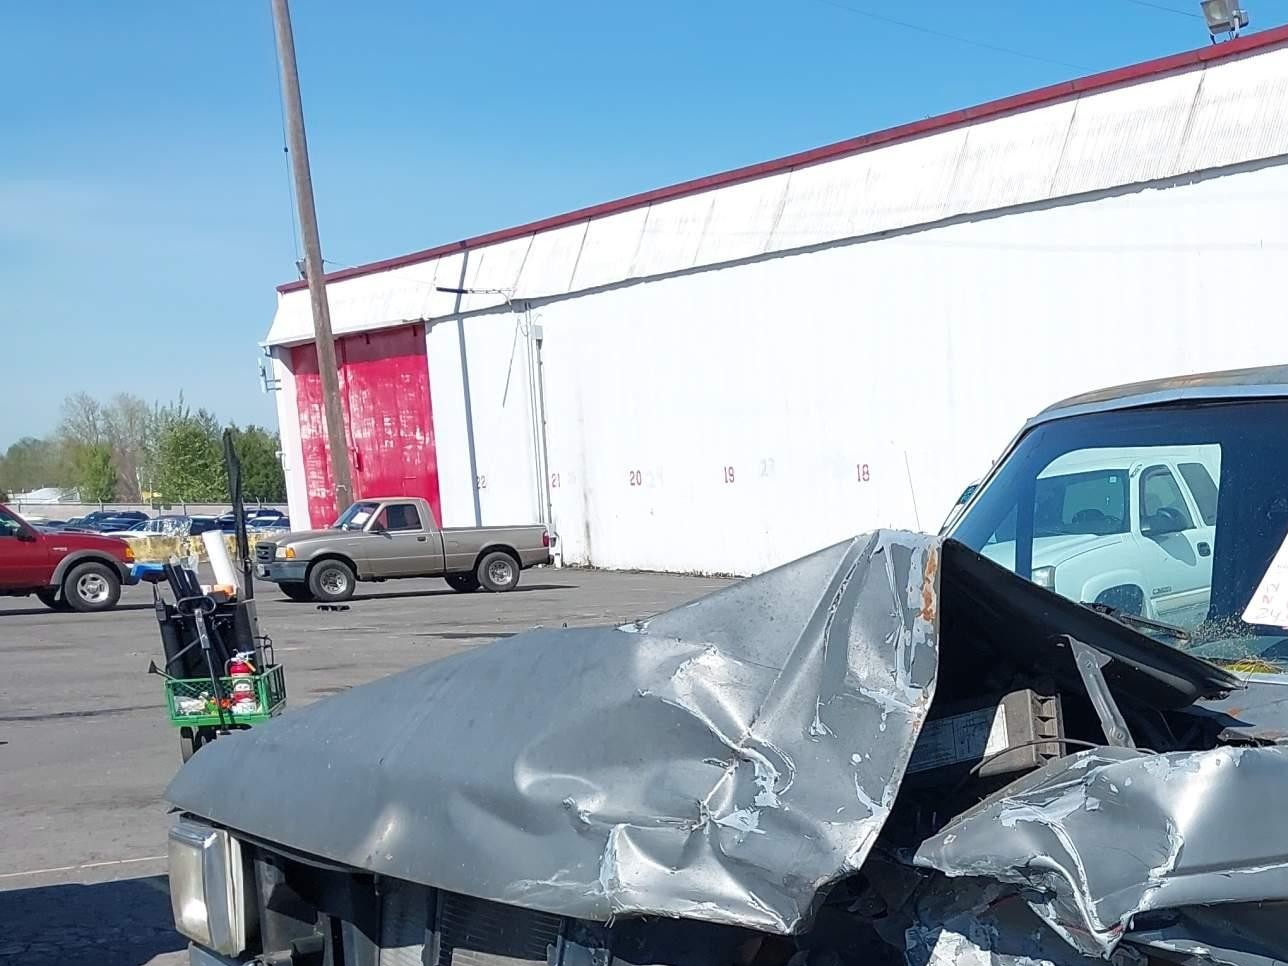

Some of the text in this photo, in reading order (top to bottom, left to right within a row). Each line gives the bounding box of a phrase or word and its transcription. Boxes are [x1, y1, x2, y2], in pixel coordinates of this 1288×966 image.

[629, 469, 642, 486] 20
[723, 466, 735, 484] 19
[856, 463, 870, 483] 18
